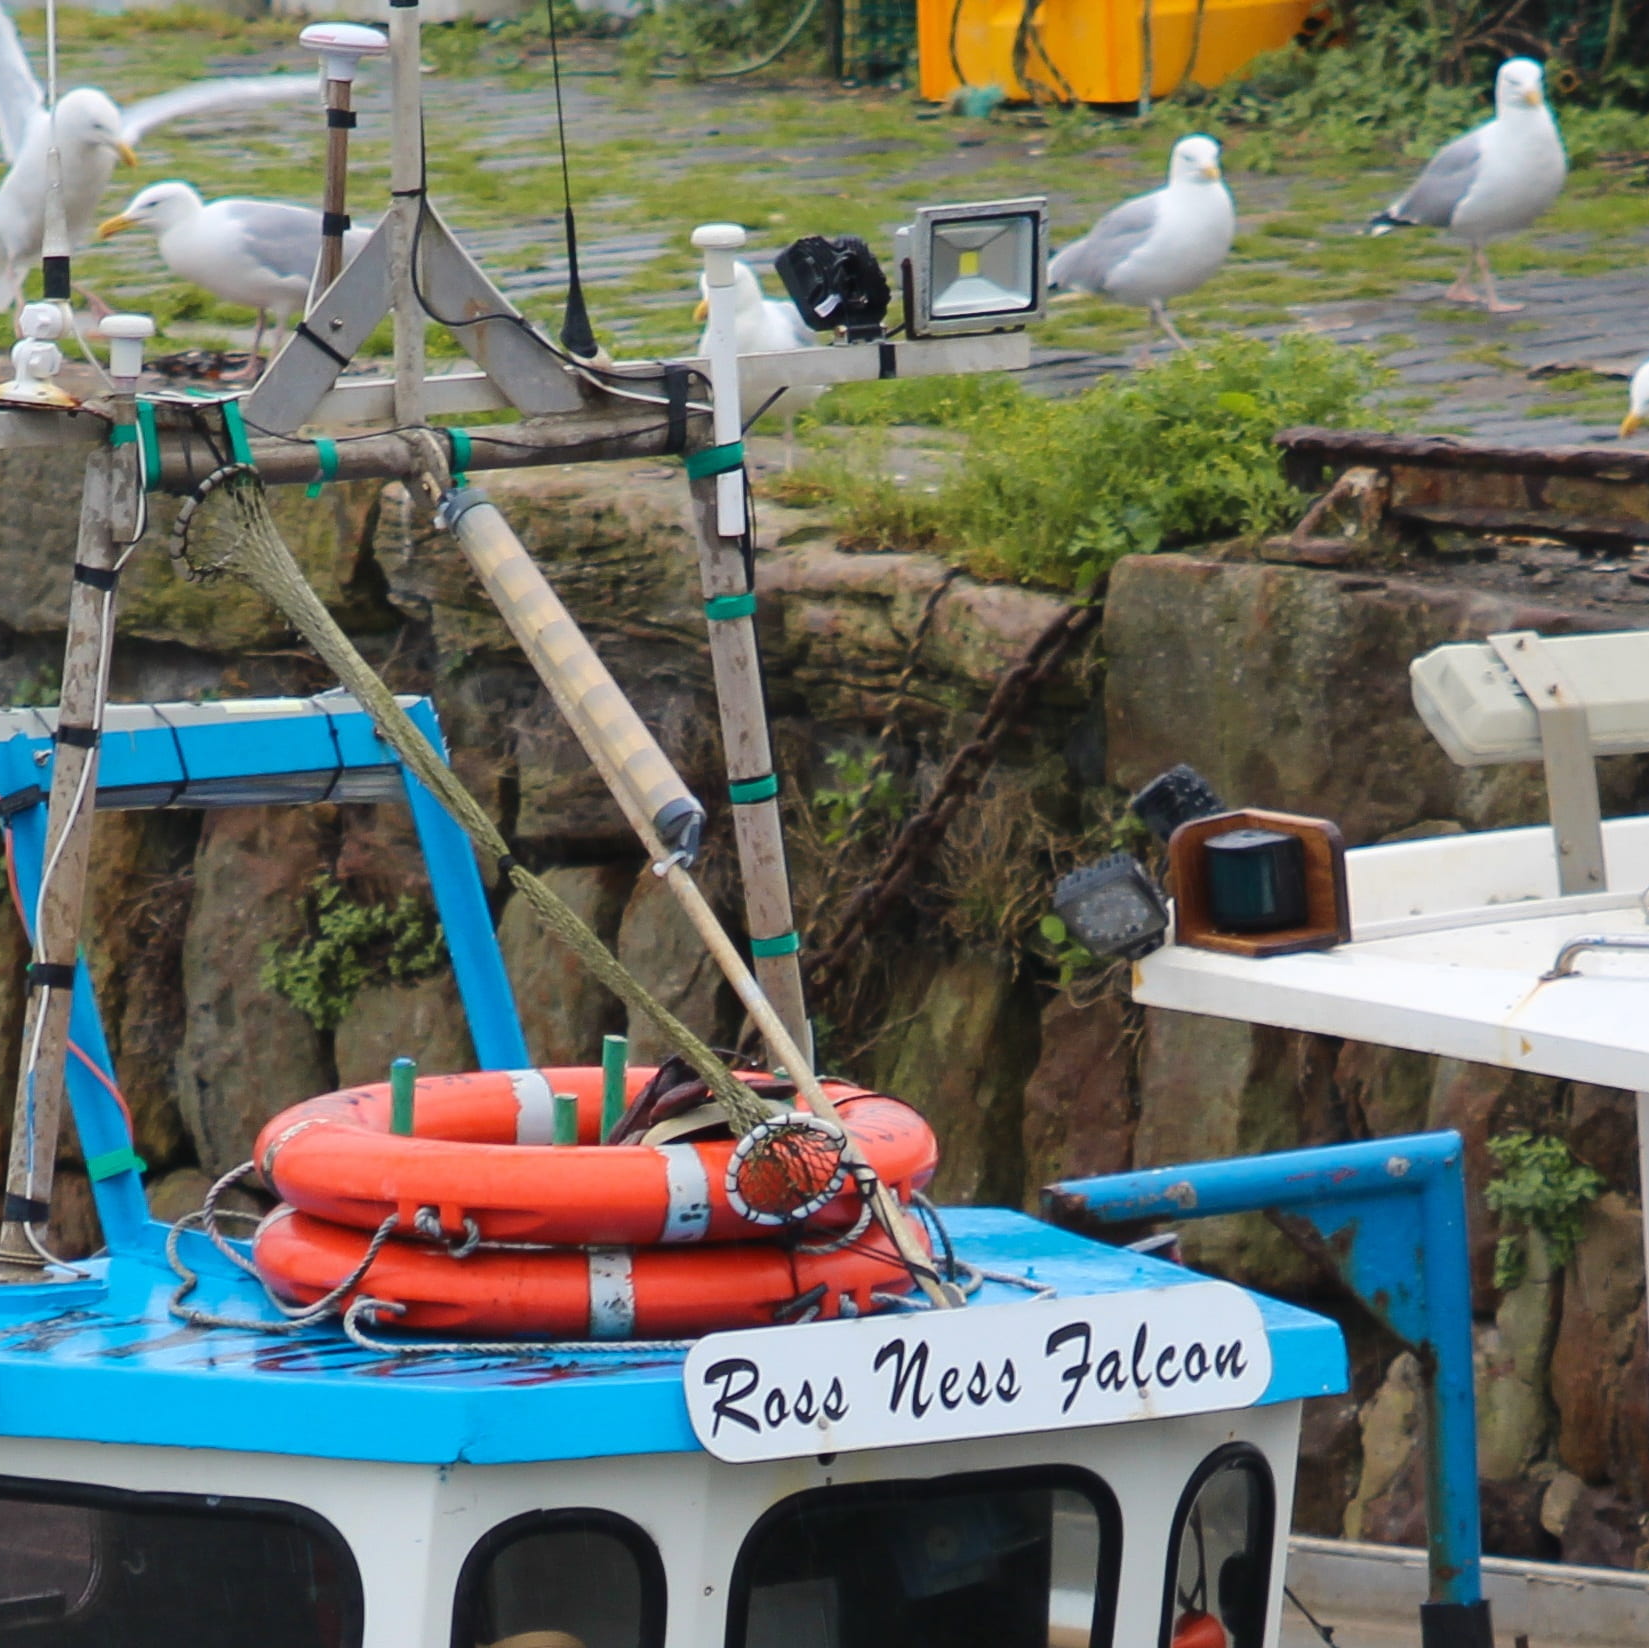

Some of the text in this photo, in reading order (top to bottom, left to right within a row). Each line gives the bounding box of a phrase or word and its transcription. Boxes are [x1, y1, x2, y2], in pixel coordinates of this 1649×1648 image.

[703, 1320, 1249, 1439] Ross Ness Falcon
